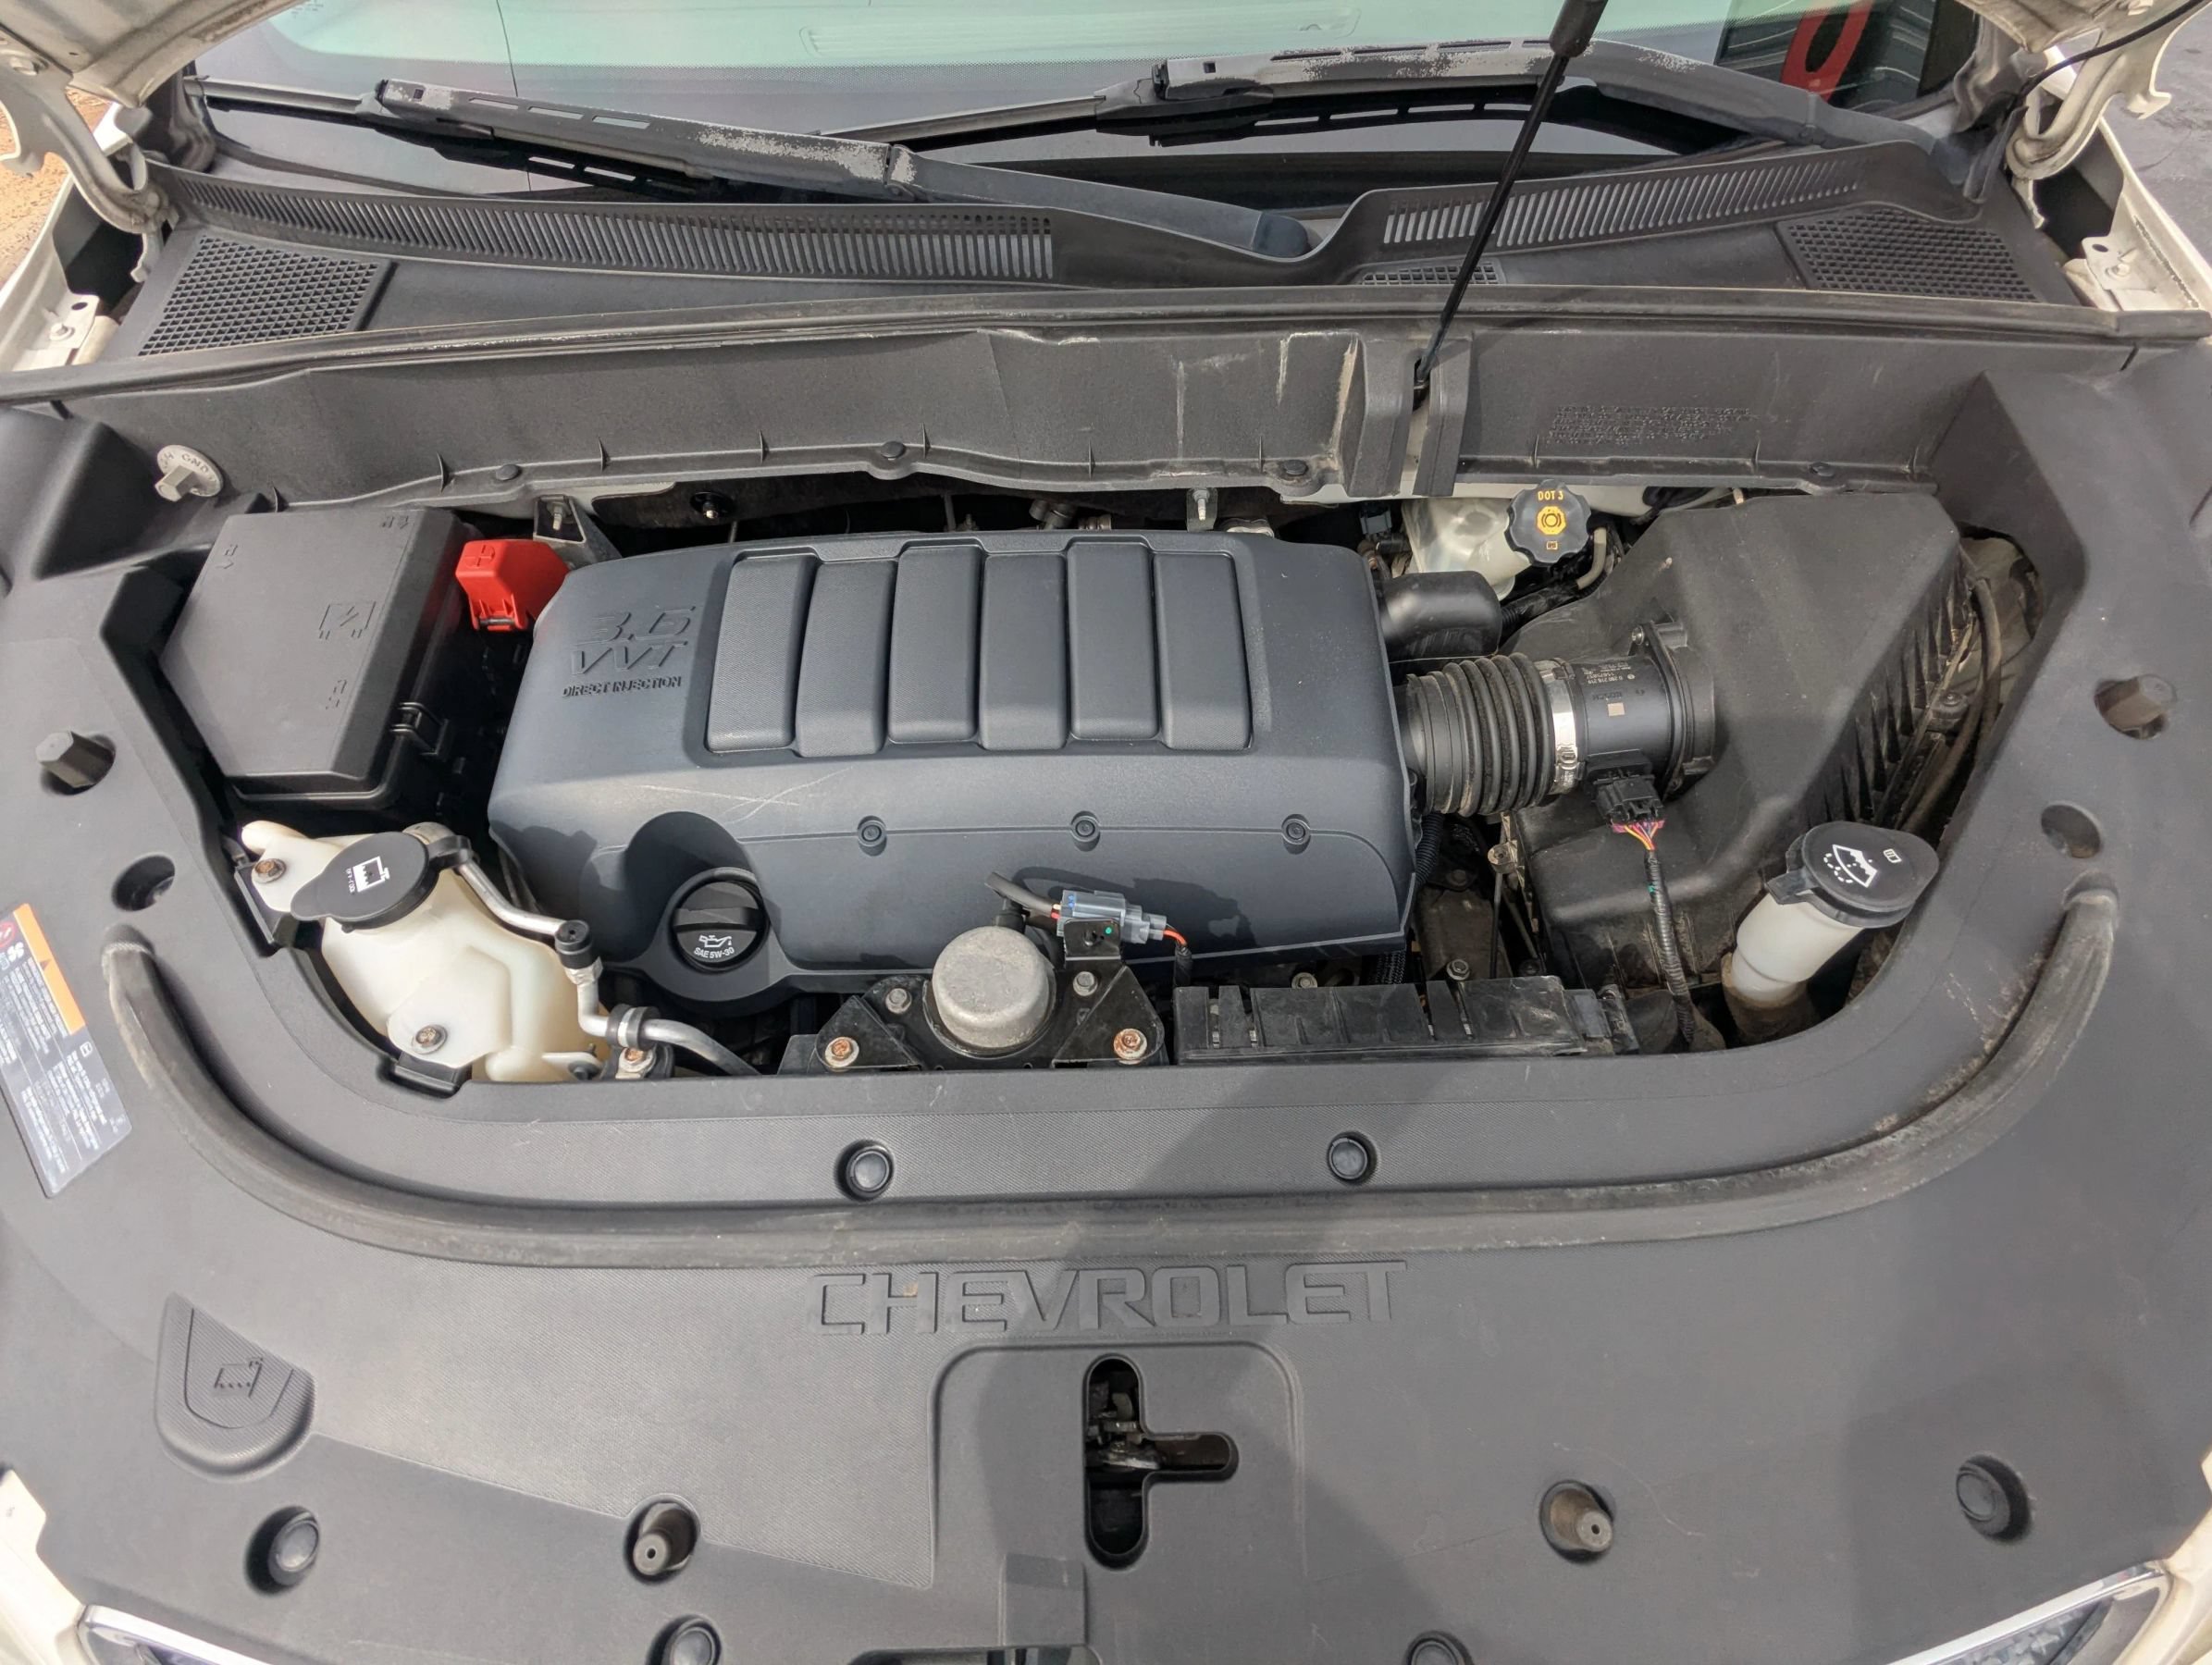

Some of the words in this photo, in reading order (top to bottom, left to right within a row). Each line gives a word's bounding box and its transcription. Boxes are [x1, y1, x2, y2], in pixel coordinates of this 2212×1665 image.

[1538, 490, 1556, 500] DOT
[1557, 490, 1563, 500] 3
[575, 606, 696, 645] 3.5
[571, 640, 688, 676] VVT
[562, 683, 611, 697] DIRECT
[612, 675, 683, 693] INJECTION
[694, 947, 709, 958] SAE
[709, 946, 735, 959] 5W-30
[805, 1260, 1409, 1336] CHEVROLET
